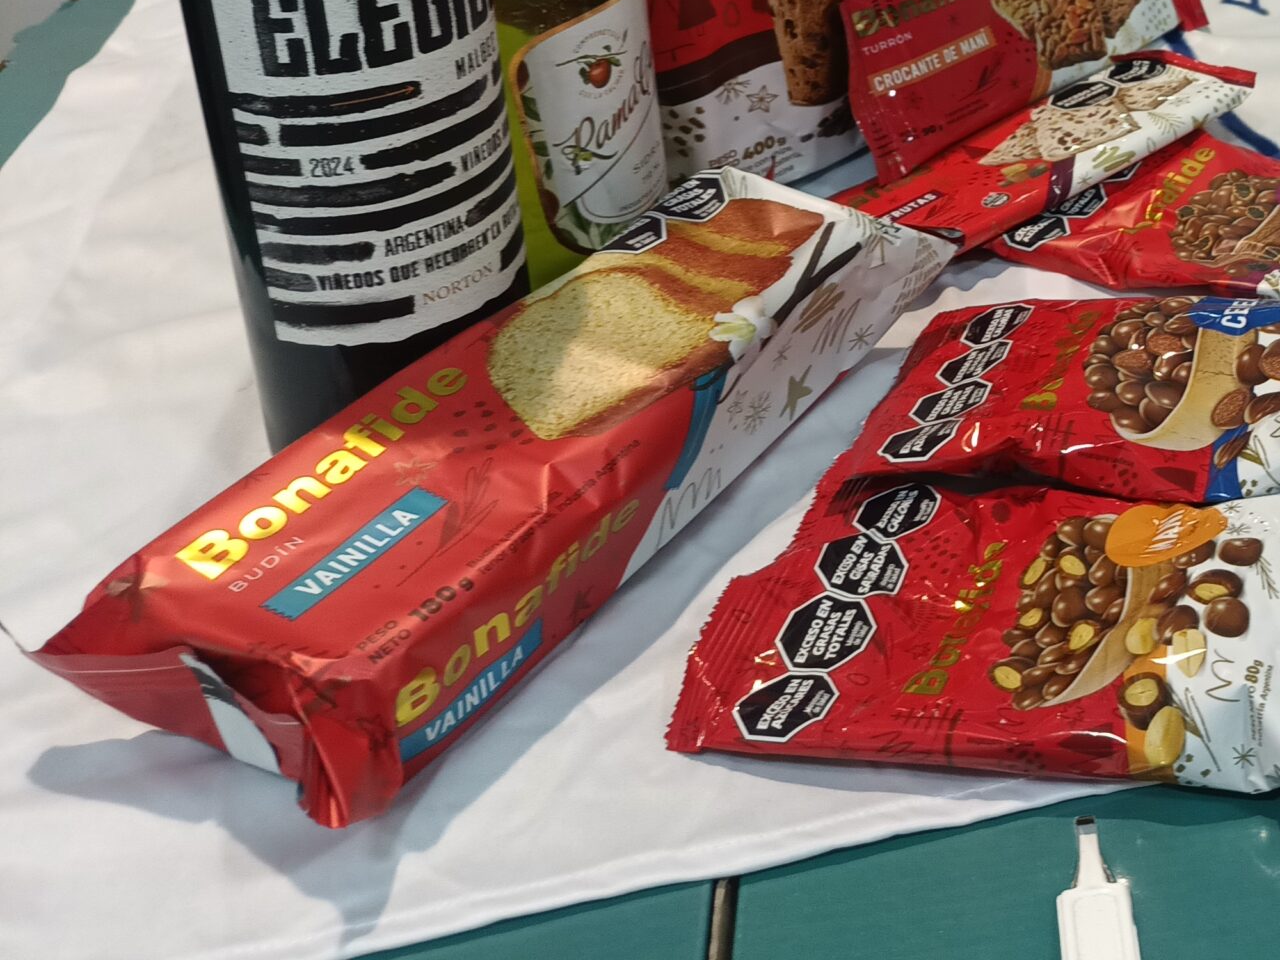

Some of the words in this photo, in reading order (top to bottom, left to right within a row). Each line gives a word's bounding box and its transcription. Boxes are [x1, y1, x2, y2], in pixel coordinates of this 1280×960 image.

[873, 53, 942, 92] CROCANTE
[943, 46, 958, 63] DE
[309, 156, 355, 178] 2024
[384, 215, 467, 257] ARGENTINA
[316, 269, 385, 291] VIÑEDOS
[389, 261, 421, 283] QUE
[422, 261, 494, 305] NORTON
[175, 367, 469, 582] Bonafide
[228, 536, 306, 593] BUDÍN
[293, 509, 420, 597] VAINILLA
[394, 498, 641, 726] Bonafide
[793, 620, 821, 664] EXCESO
[815, 599, 834, 619] EN
[812, 611, 842, 656] GRASAS
[823, 608, 858, 661] TOTALES
[368, 628, 412, 665] NETO
[426, 645, 525, 742] VAINILLA
[1243, 658, 1265, 685] 80g
[756, 693, 792, 730] EXCESO
[783, 678, 802, 695] EN
